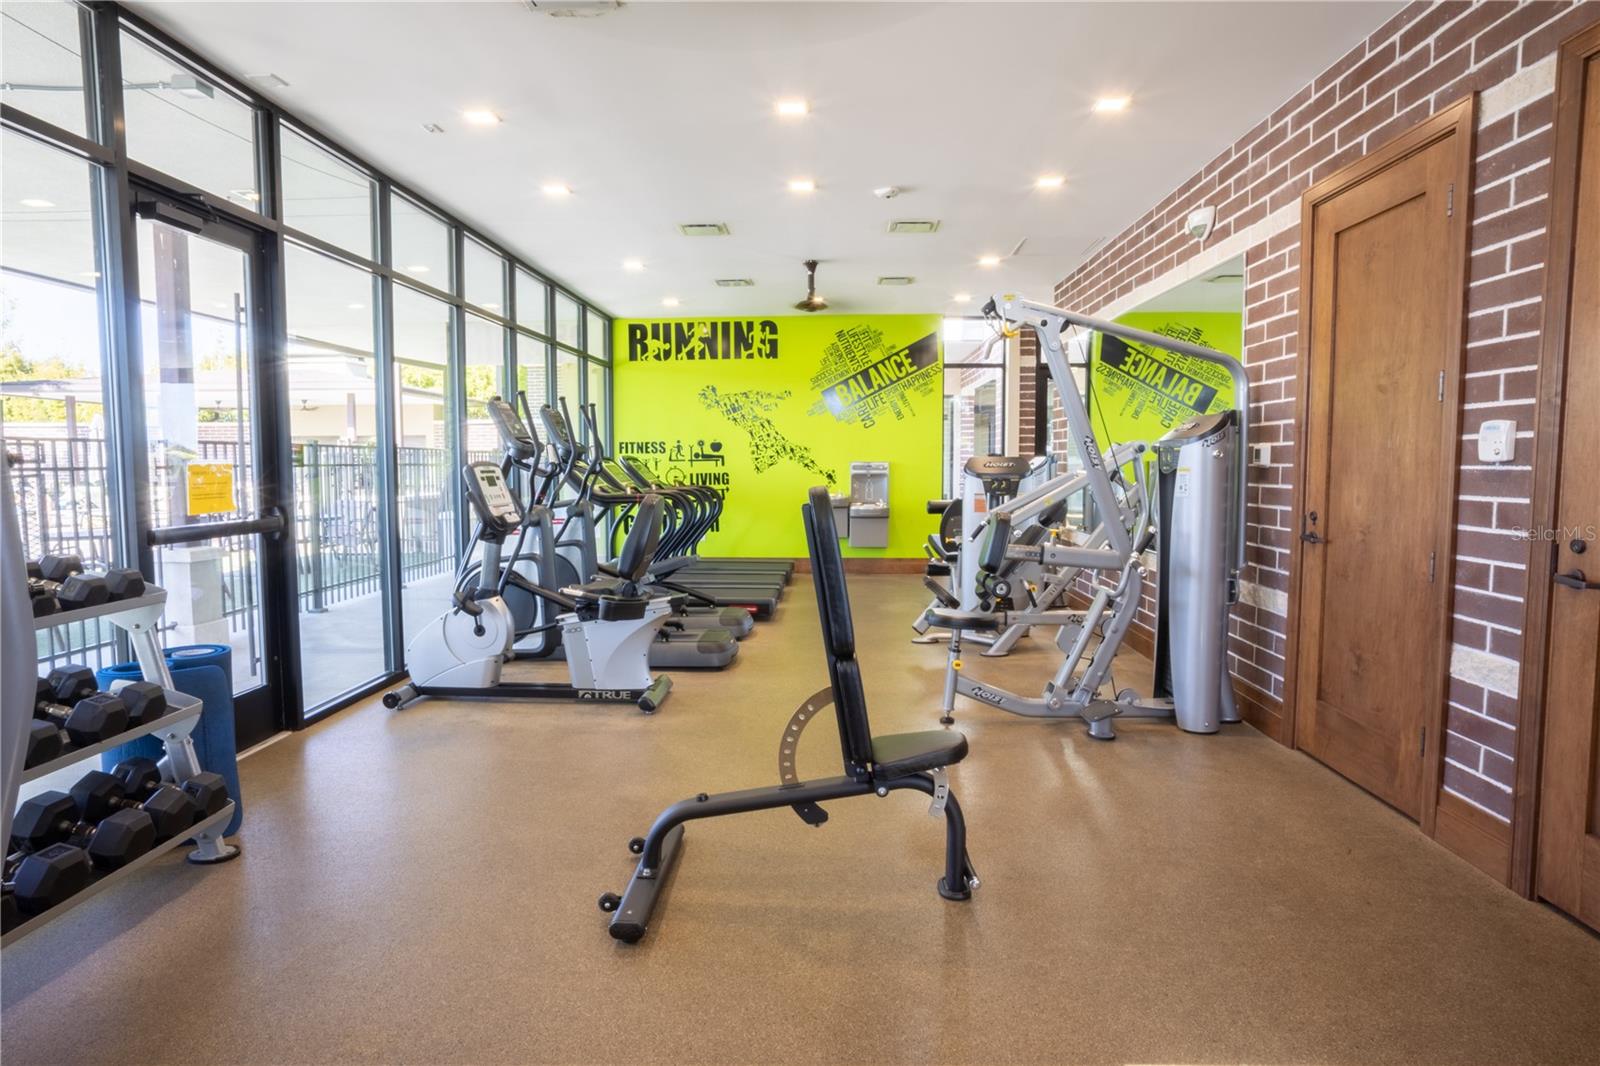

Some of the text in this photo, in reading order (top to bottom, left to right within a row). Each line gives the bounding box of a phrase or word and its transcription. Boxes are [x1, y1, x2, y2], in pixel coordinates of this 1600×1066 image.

[628, 320, 778, 361] RUNNING
[835, 329, 863, 372] NUTRIENTS
[846, 327, 873, 368] LIFESTYLE
[810, 368, 835, 385] SUCCESS
[835, 349, 918, 407] BALANCE
[902, 364, 943, 391] HAPPINESS
[855, 401, 876, 429] CARE
[866, 392, 887, 411] LIFE
[619, 441, 666, 454] FITNESS
[1084, 433, 1102, 471] HOIST
[689, 472, 729, 486] LIVING
[591, 690, 632, 699] TRUE
[972, 686, 1008, 705] HOIST
